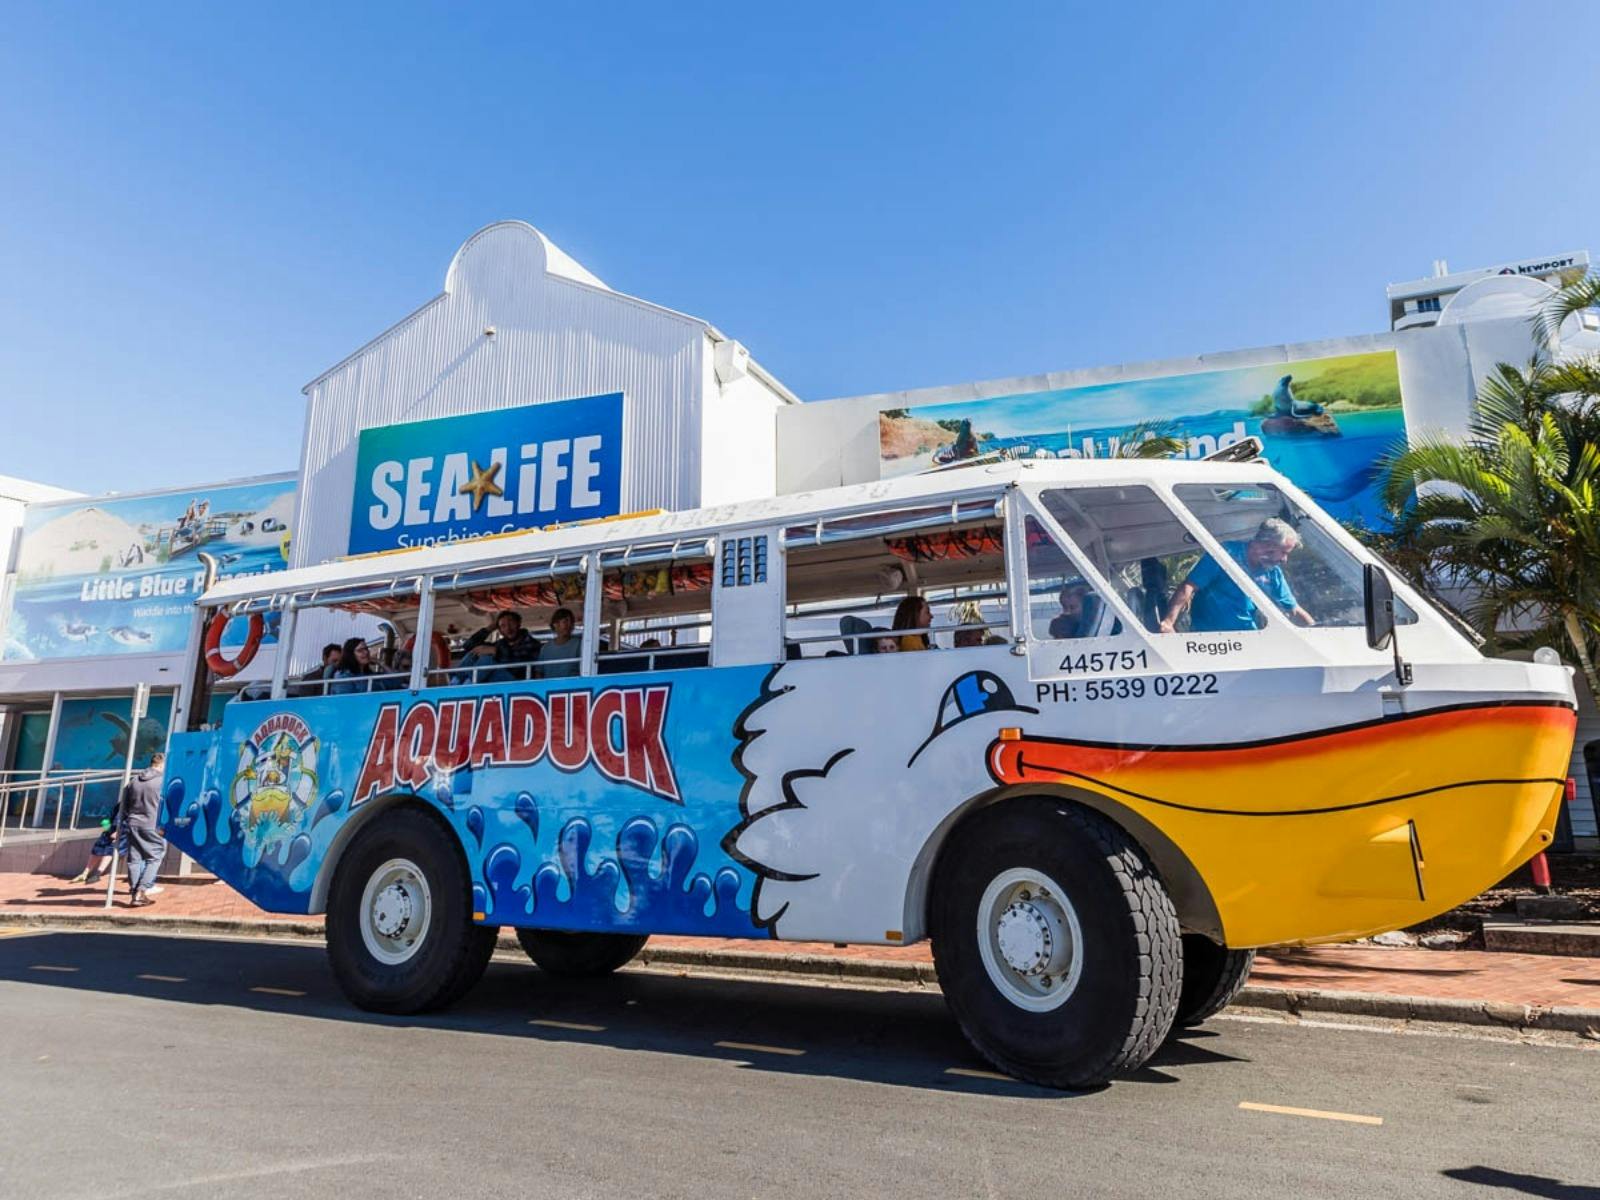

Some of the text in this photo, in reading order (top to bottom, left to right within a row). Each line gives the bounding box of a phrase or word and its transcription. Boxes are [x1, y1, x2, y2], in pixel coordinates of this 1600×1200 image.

[1518, 258, 1574, 274] NEWPORT
[368, 452, 472, 531] SEA
[80, 575, 133, 602] Little
[139, 573, 186, 598] Blue
[1059, 649, 1148, 674] 445751
[1186, 639, 1243, 655] Reggie
[1036, 673, 1219, 703] PH: 5539 0222
[253, 714, 309, 746] AQUADUCK
[350, 686, 682, 806] AQUADUCK
